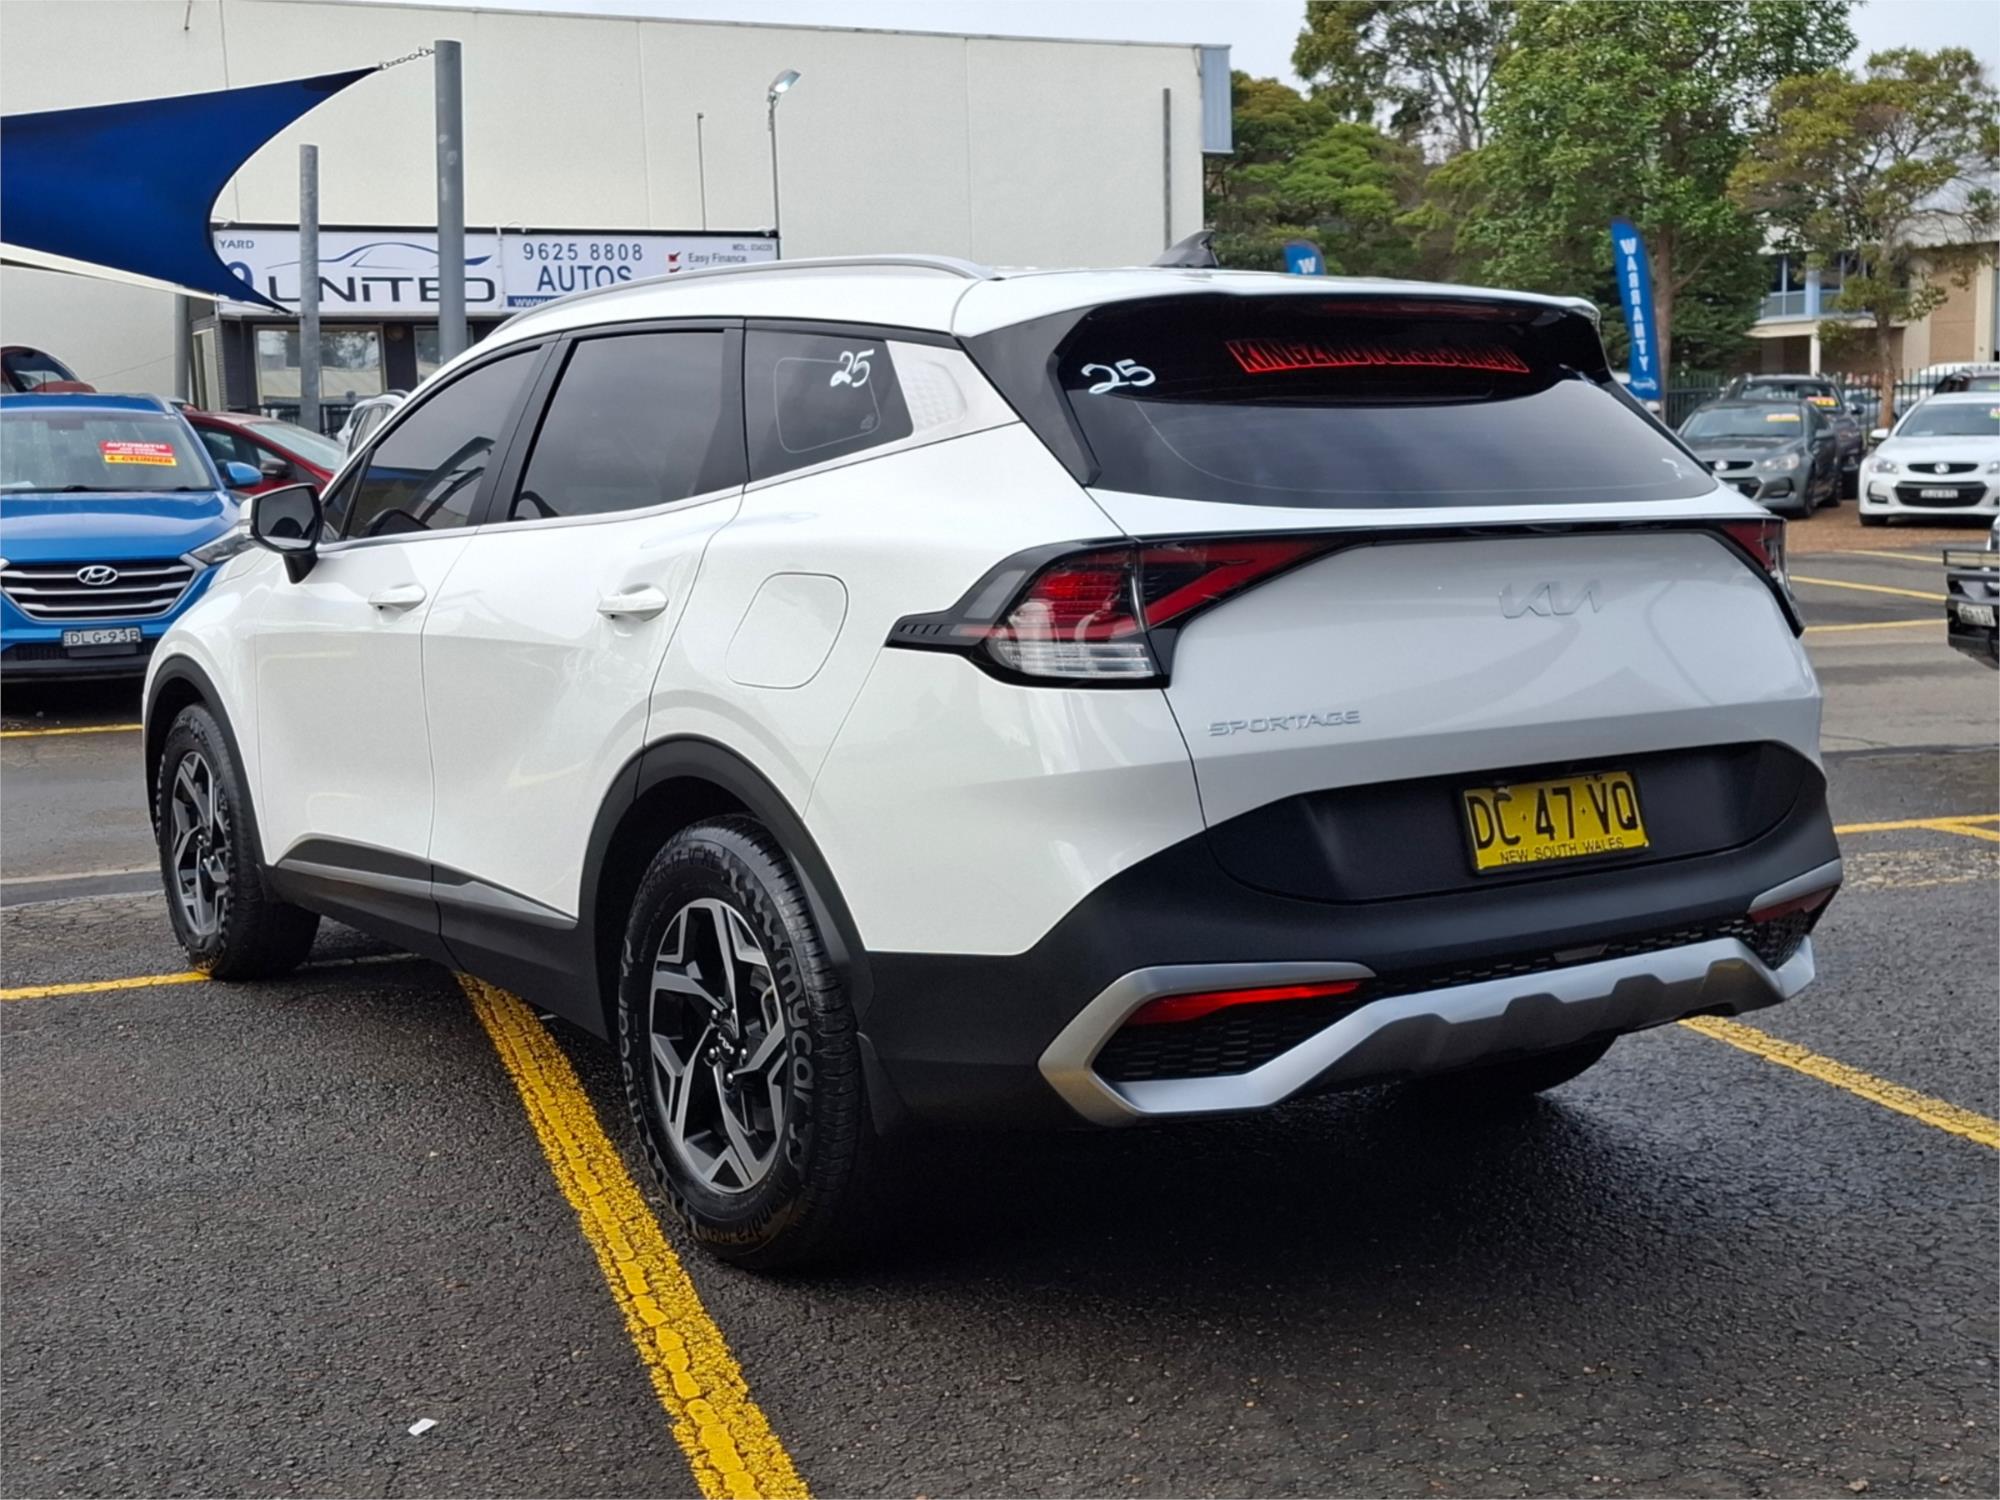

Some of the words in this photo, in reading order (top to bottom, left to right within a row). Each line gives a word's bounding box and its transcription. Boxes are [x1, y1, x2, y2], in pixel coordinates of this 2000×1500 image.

[219, 239, 254, 249] YARD
[523, 242, 578, 261] 9625
[590, 242, 643, 261] 8808
[688, 252, 709, 263] Easy
[712, 252, 746, 263] Finance
[268, 275, 496, 302] UNITED
[536, 264, 633, 292] AUTOS
[1619, 237, 1649, 372] WARRANTY
[829, 348, 875, 388] 25
[1080, 358, 1157, 395] 25
[1208, 709, 1363, 737] SPORTAGE
[1500, 850, 1529, 865] NEW
[1534, 843, 1578, 861] SOUTH
[1583, 836, 1625, 855] WALES
[777, 954, 815, 1106] mycar
